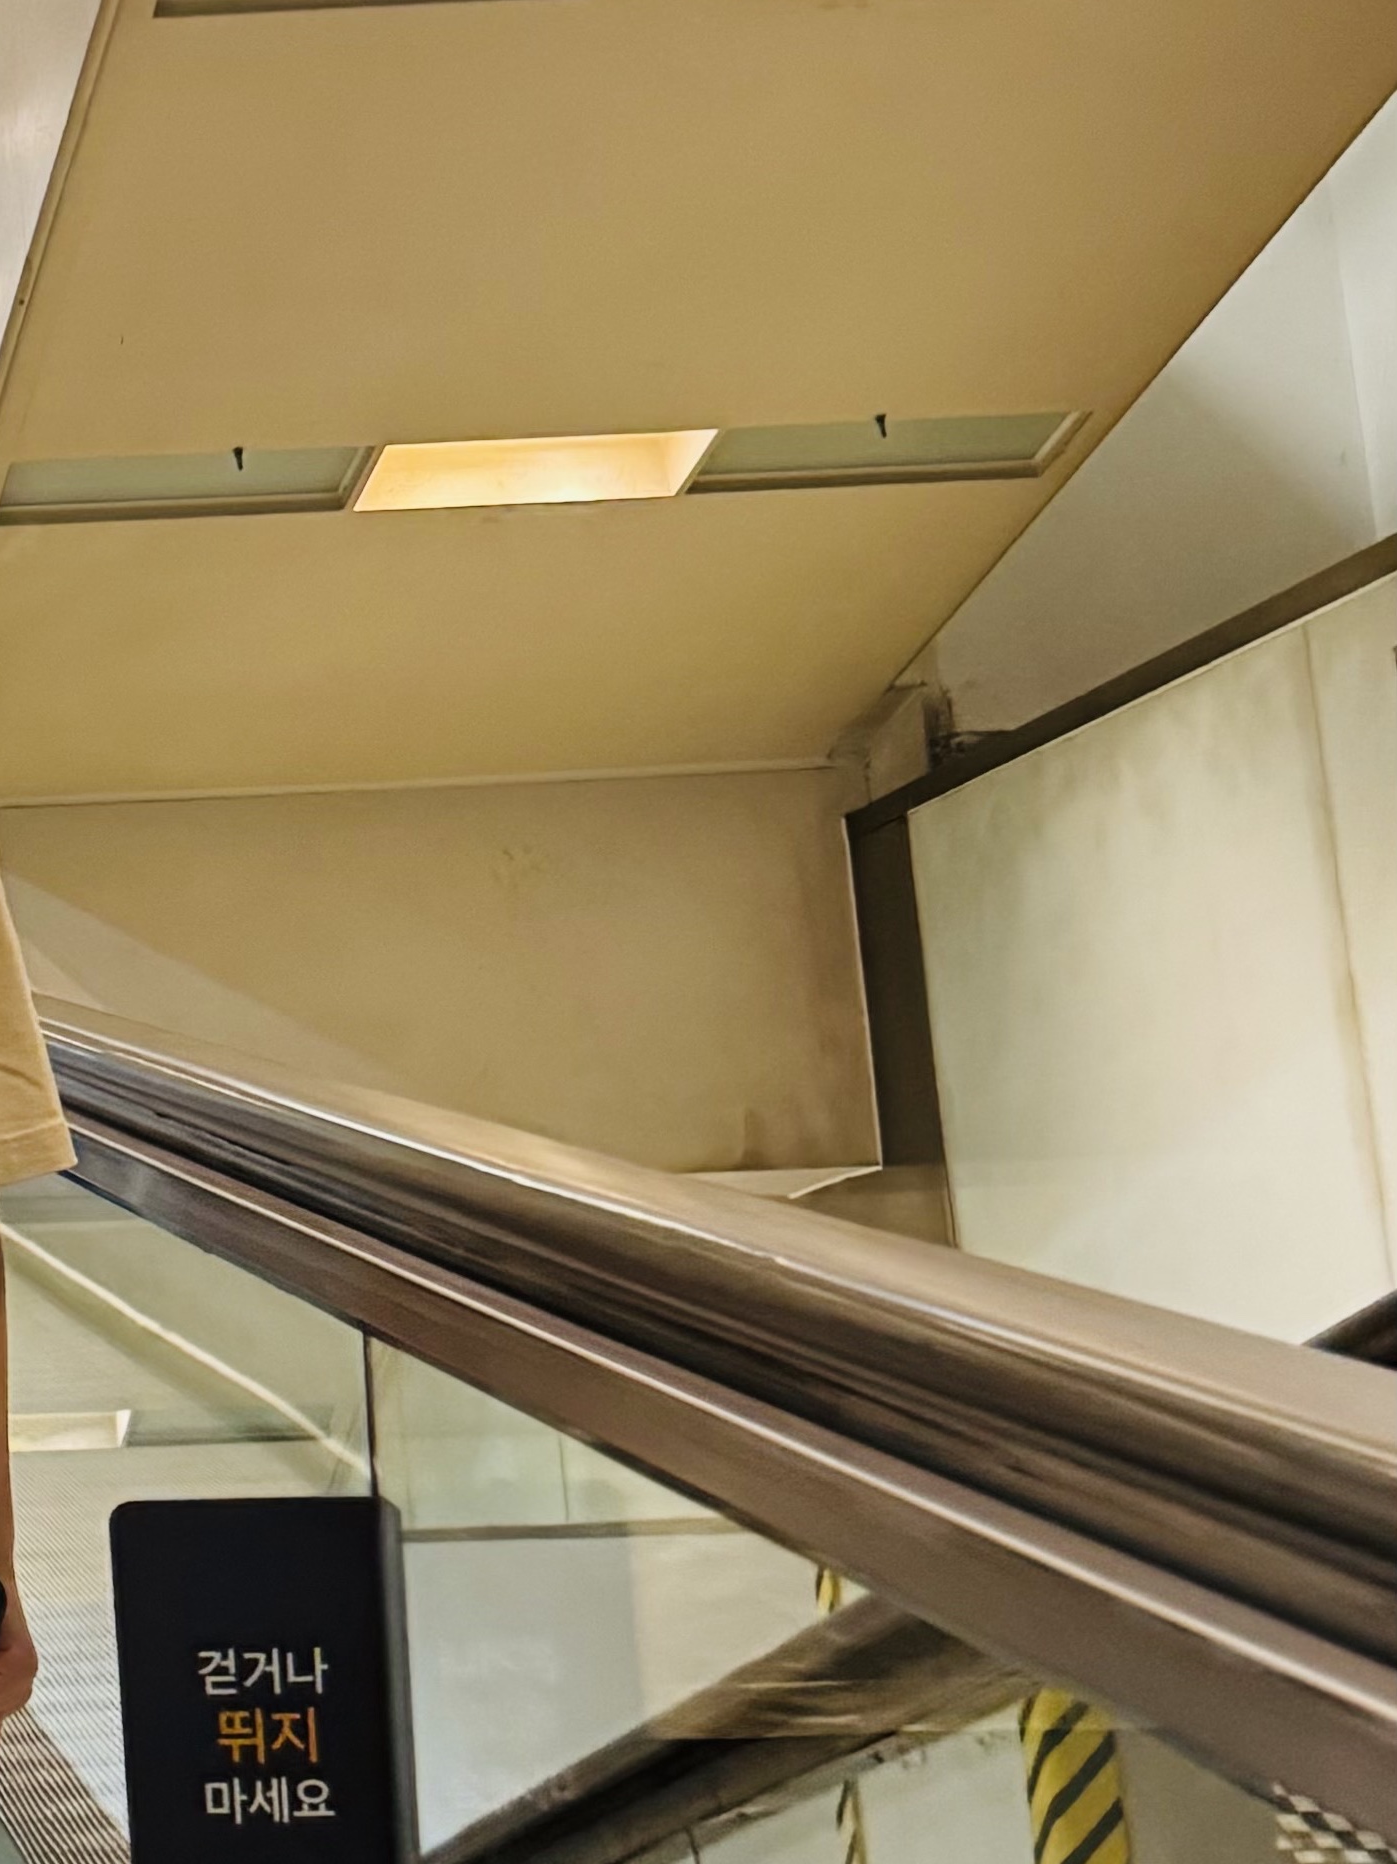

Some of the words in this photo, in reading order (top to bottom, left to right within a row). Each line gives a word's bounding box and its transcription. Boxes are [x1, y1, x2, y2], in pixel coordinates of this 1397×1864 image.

[197, 1646, 330, 1697] 걷거나
[217, 1707, 320, 1764] 뛰지
[205, 1778, 336, 1826] 마세요
